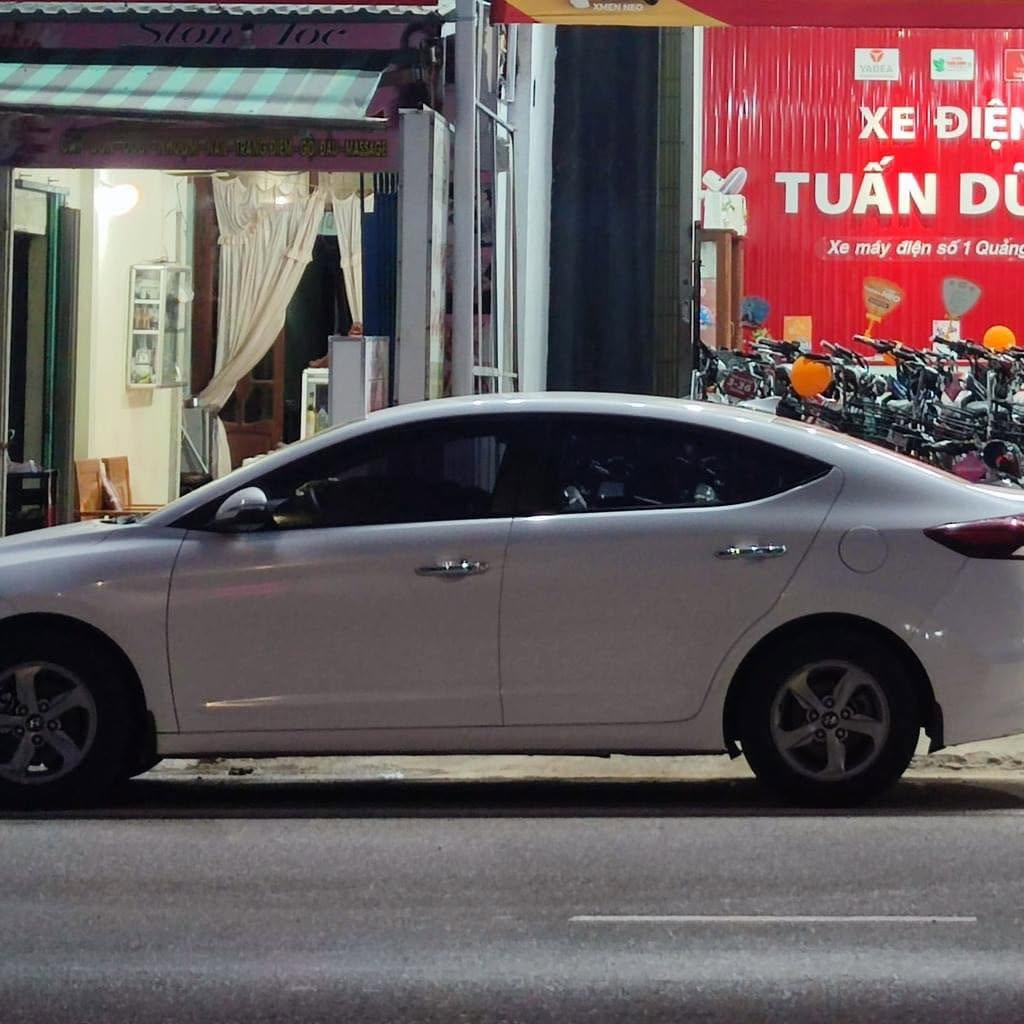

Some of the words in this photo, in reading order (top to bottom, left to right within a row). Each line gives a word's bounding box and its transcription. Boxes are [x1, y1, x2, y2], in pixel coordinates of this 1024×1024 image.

[858, 106, 916, 140] XE
[775, 155, 937, 216] TUẤN
[828, 239, 849, 255] Xe
[855, 239, 890, 258] máy
[936, 238, 961, 256] số
[962, 240, 970, 255] 1
